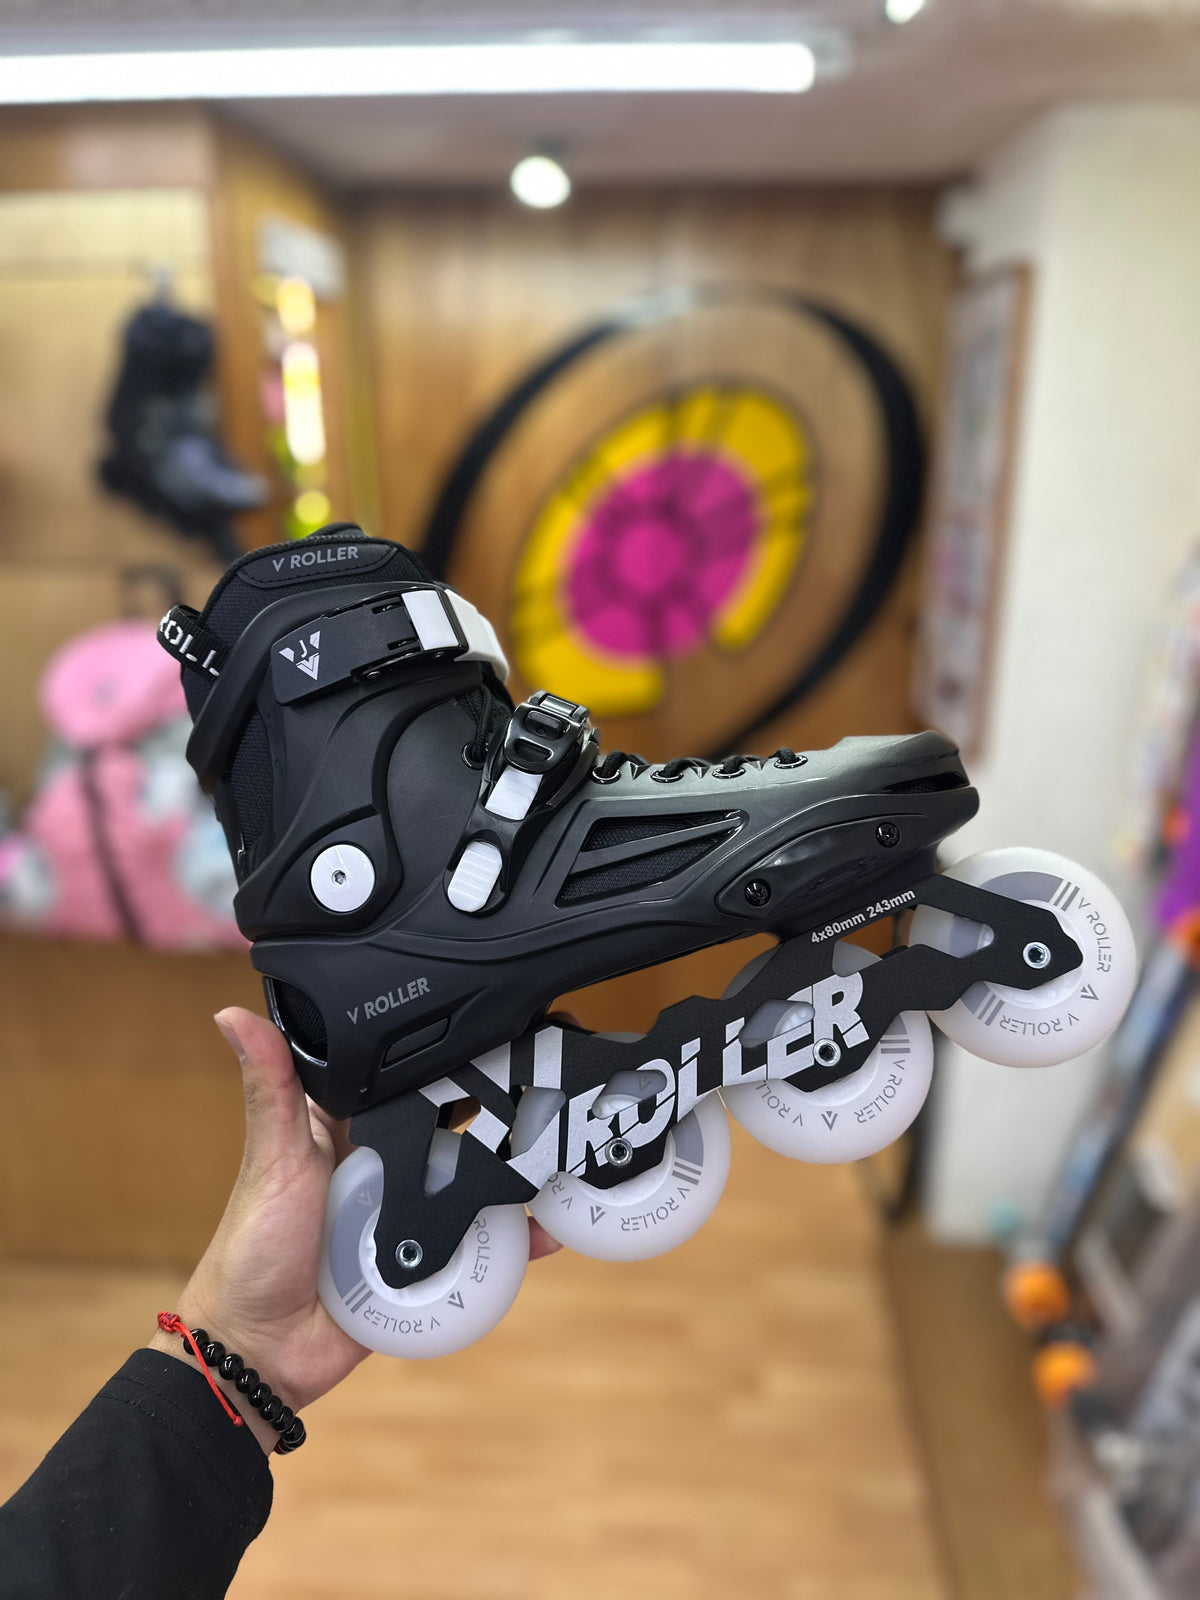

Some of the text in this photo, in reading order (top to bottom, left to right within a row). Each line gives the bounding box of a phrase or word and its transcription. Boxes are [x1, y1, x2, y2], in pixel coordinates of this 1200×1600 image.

[272, 546, 359, 573] V ROLLER
[810, 888, 916, 945] 4x80mm 243mm
[1077, 896, 1112, 974] V ROLLER
[346, 977, 431, 1025] V ROLLER
[999, 1012, 1081, 1036] V ROLLER
[854, 1058, 906, 1125] V ROLLER
[792, 1112, 803, 1127] V
[620, 1186, 691, 1232] V ROLLER
[470, 1217, 491, 1284] ROLLER
[363, 1305, 441, 1335] V ROLLER
